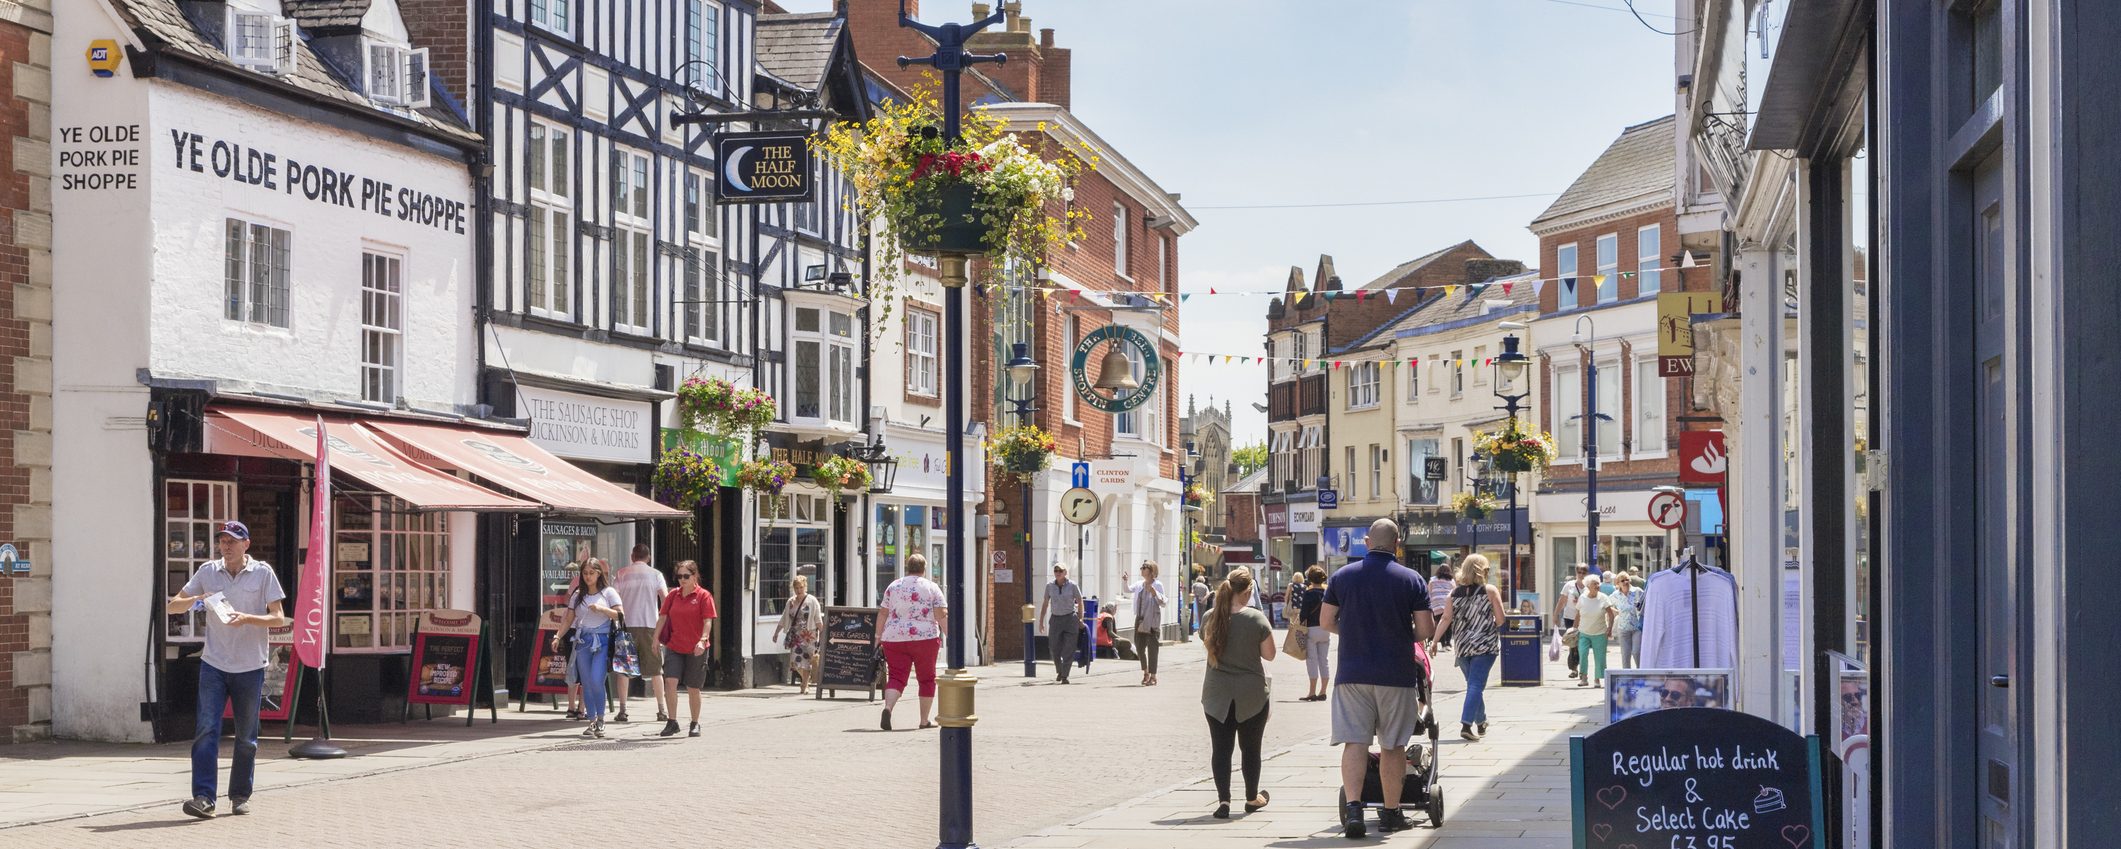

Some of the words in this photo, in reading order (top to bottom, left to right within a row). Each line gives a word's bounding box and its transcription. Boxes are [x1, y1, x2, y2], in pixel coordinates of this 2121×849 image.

[92, 50, 106, 59] ADT
[59, 127, 82, 143] YE
[90, 124, 140, 143] OLDE
[60, 149, 108, 167] PORK
[112, 149, 139, 166] PIE
[762, 146, 792, 159] THE
[755, 160, 796, 174] HALF
[62, 173, 137, 190] SHOPPE
[171, 128, 204, 174] YE
[212, 140, 276, 191] OLDE
[286, 159, 356, 209] PORK
[362, 178, 392, 216] PIE
[397, 187, 466, 236] SHOPPE
[751, 174, 801, 188] MOON
[1080, 336, 1100, 353] THE
[1074, 368, 1109, 409] SHOPPIN
[1124, 370, 1156, 408] CENTRE
[532, 398, 555, 420] THE
[558, 402, 608, 426] SAUSAGE
[610, 408, 638, 430] SHOP
[529, 422, 588, 445] DICKINSON
[590, 428, 598, 445] &
[600, 429, 639, 449] MORRIS
[772, 447, 788, 462] THE
[792, 449, 812, 464] HALF
[543, 525, 574, 535] SAUSAGES
[575, 526, 580, 535] &
[581, 526, 597, 536] BACON
[542, 570, 570, 579] AVAILABLE
[1612, 746, 1690, 787] Regular
[1694, 745, 1724, 770] hot
[1732, 745, 1780, 770] drink
[1684, 778, 1704, 803] &
[1636, 806, 1696, 833] Select
[1702, 807, 1750, 830] Cake
